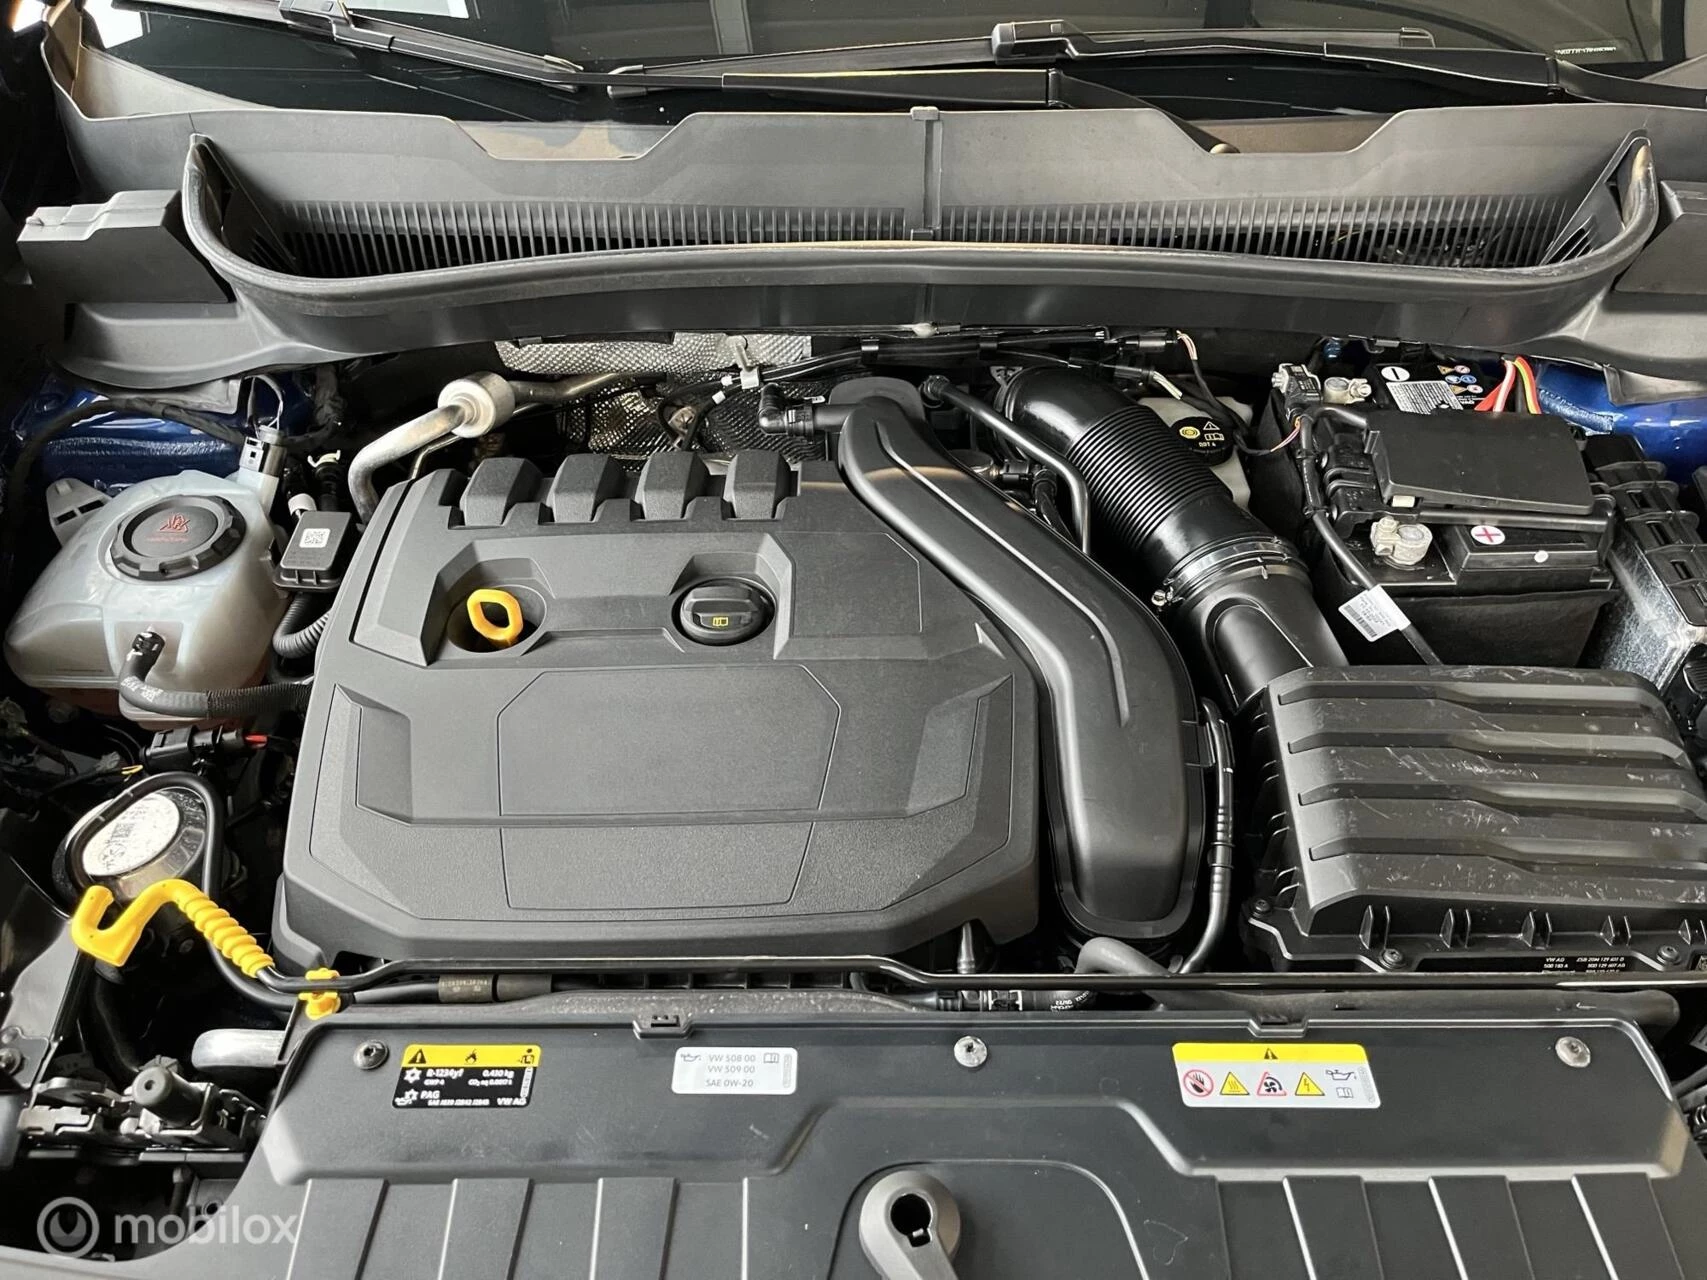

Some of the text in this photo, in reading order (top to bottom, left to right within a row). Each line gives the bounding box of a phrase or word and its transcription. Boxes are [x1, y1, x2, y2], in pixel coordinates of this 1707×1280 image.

[708, 1054, 757, 1062] VW 508 00
[707, 1065, 755, 1073] VW 509 00
[426, 1068, 464, 1079] R-1234yf
[505, 1069, 514, 1079] kg
[705, 1079, 754, 1087] SAE 0W-20
[420, 1090, 440, 1099] PAG
[496, 1097, 512, 1106] VW
[512, 1097, 527, 1106] AG
